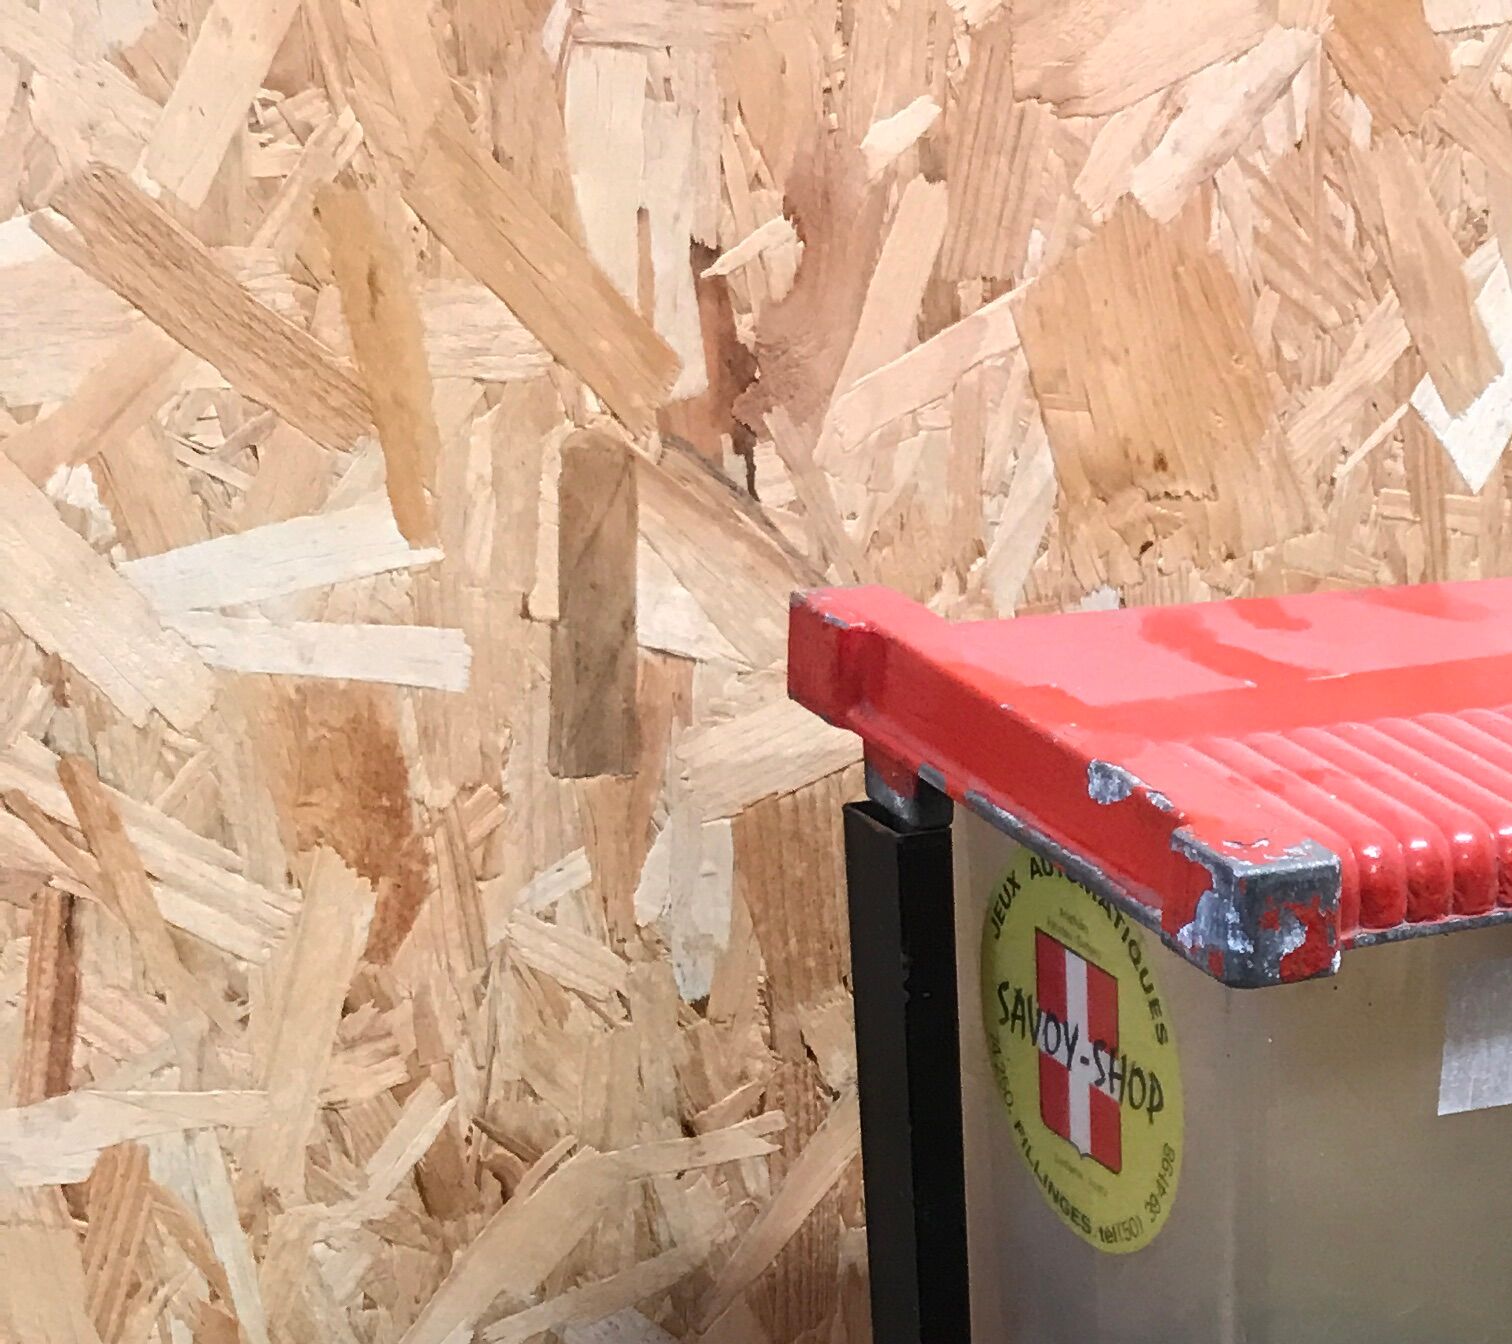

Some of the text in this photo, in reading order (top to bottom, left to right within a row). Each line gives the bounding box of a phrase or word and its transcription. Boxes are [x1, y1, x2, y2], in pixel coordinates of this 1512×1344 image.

[990, 869, 1022, 940] JEUX
[1029, 855, 1169, 1046] AUATIQUES
[997, 980, 1165, 1125] SAVOY-SHOP
